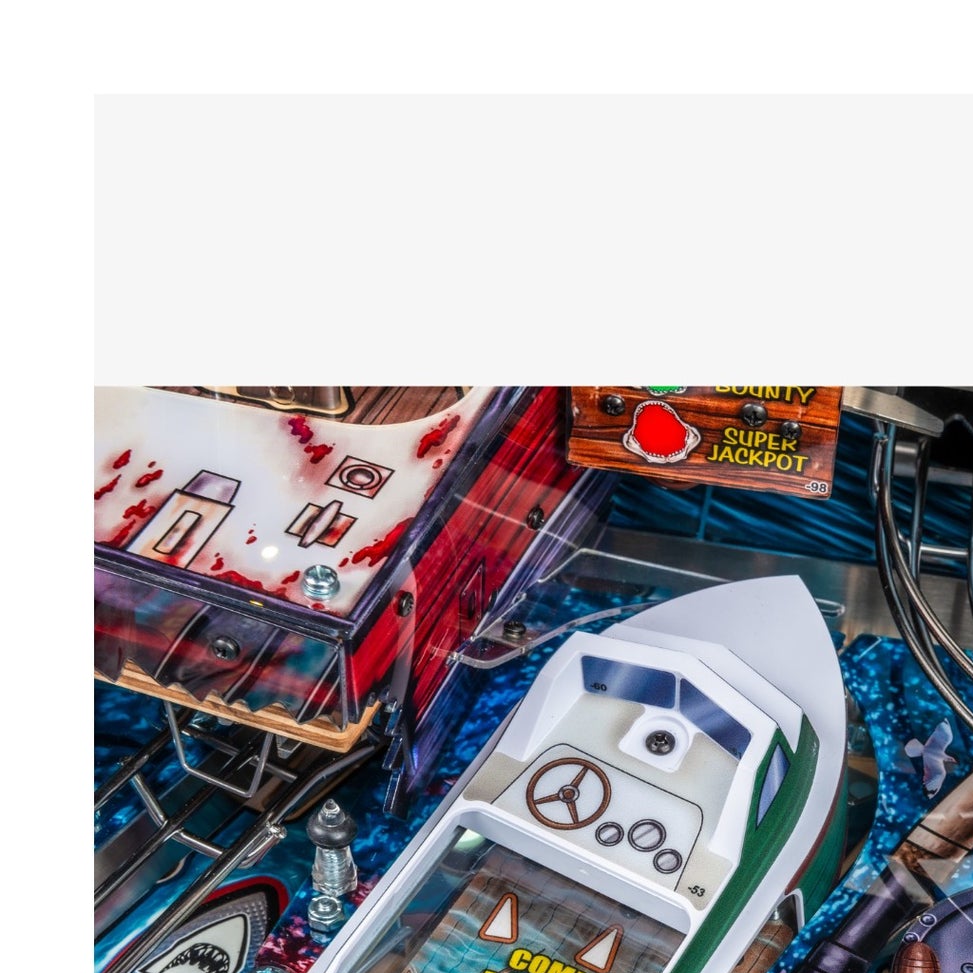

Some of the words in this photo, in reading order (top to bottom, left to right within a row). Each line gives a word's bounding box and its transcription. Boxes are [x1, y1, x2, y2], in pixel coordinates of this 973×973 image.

[723, 427, 798, 451] SUPER
[707, 444, 809, 472] JACKPOT
[805, 482, 828, 493] -98
[687, 885, 706, 897] -53
